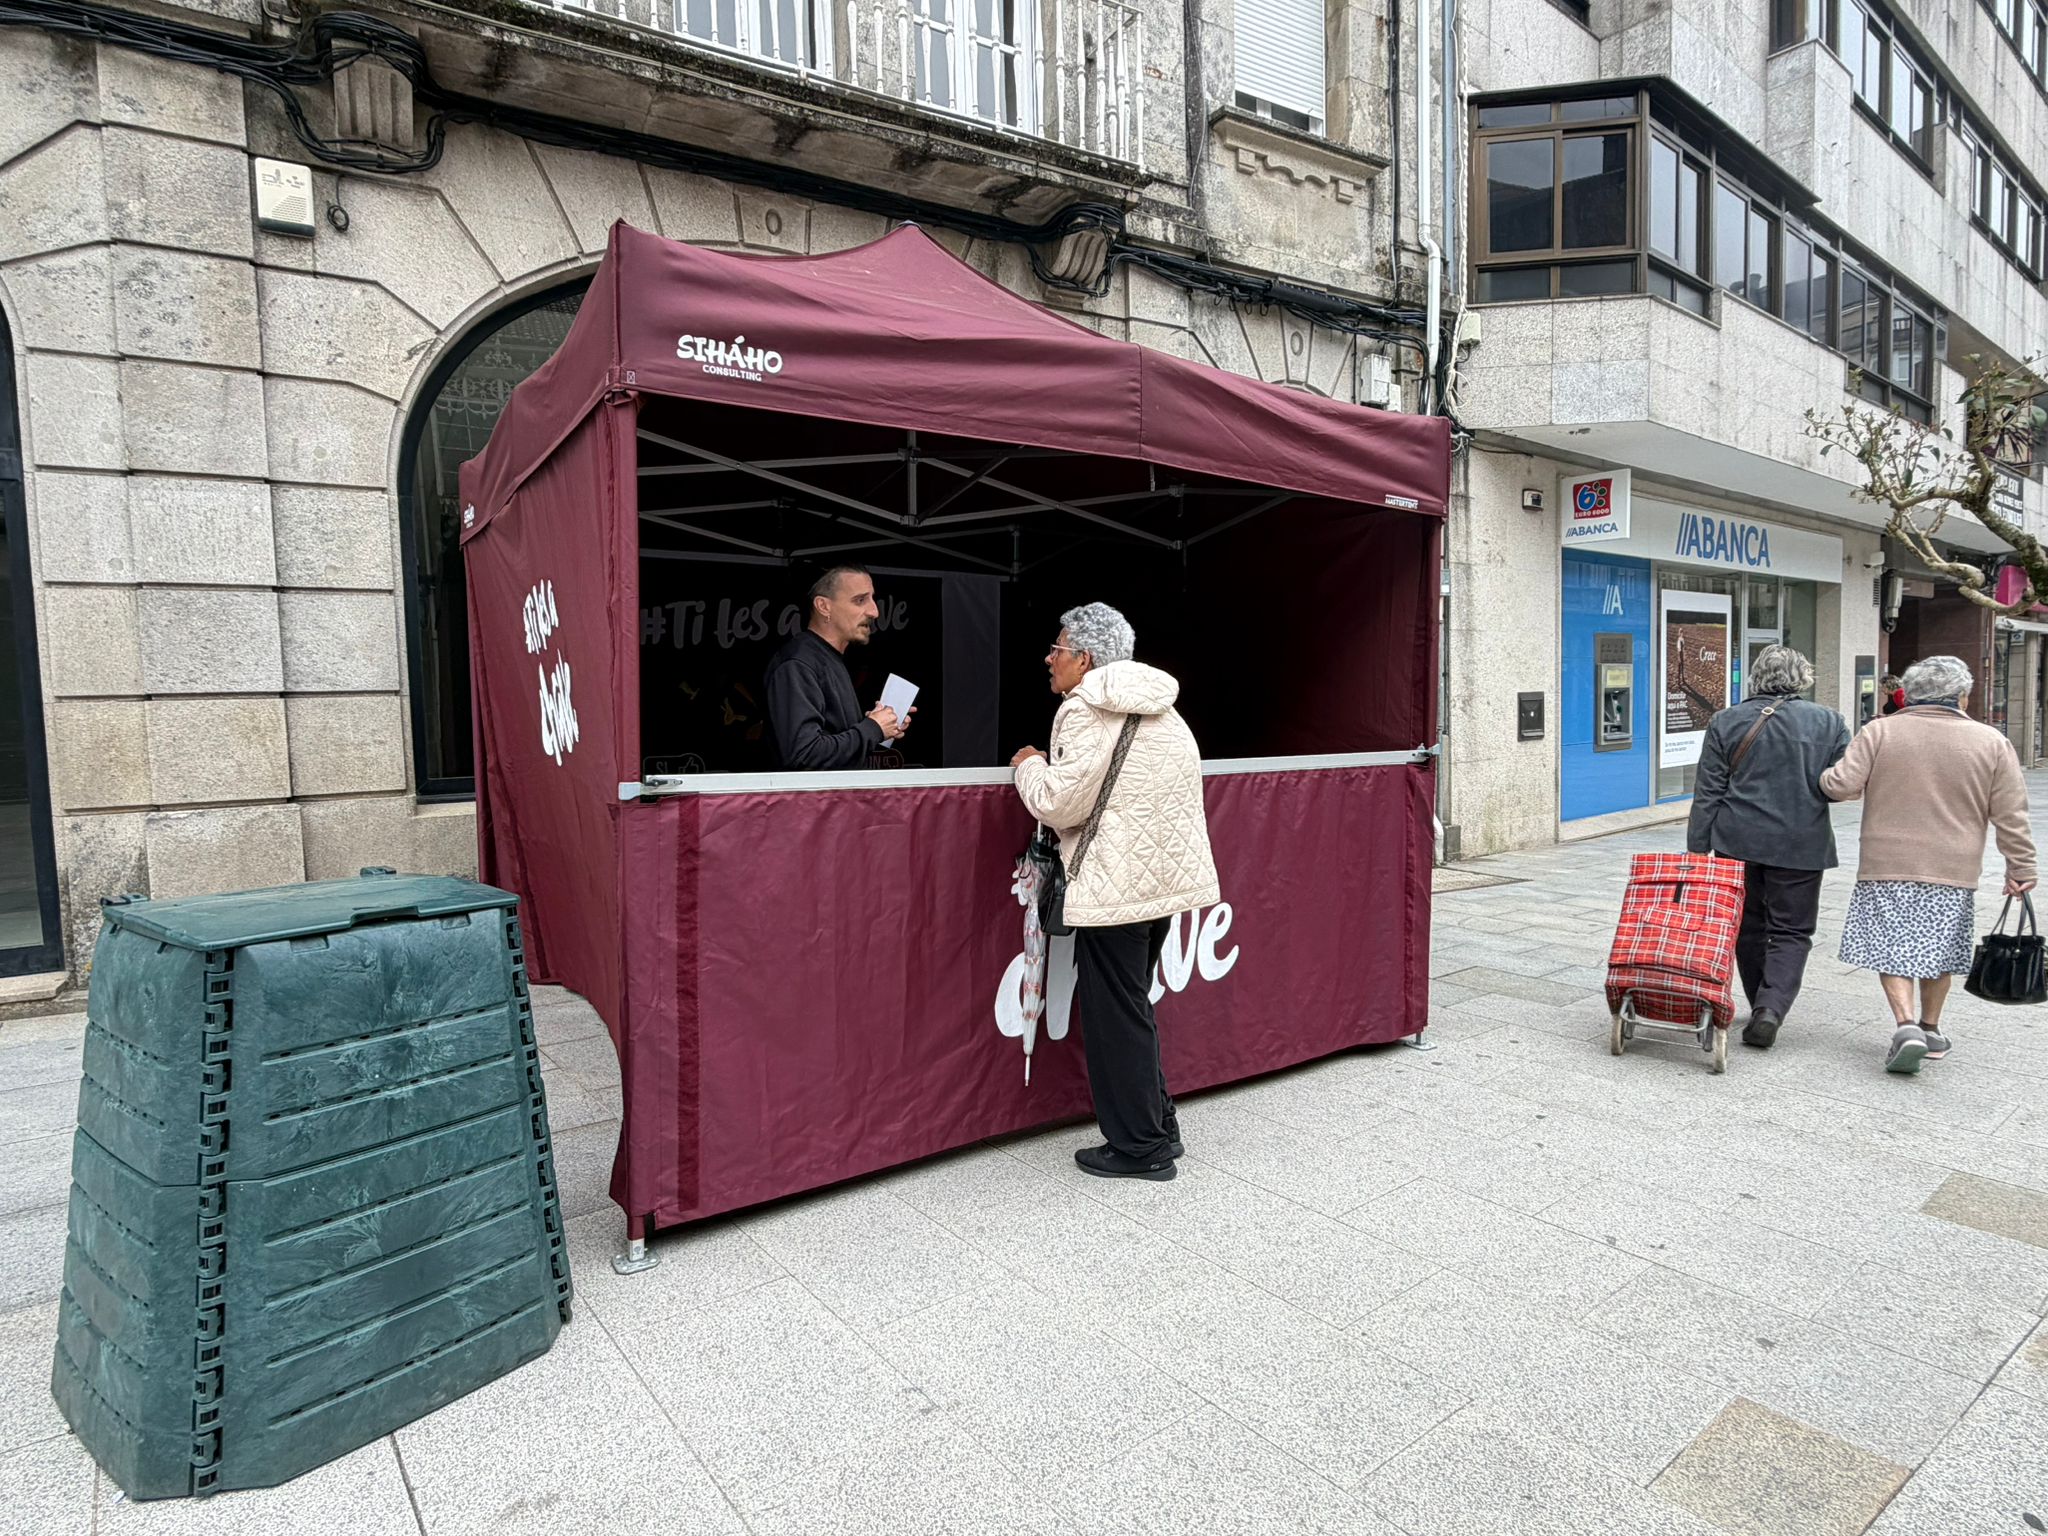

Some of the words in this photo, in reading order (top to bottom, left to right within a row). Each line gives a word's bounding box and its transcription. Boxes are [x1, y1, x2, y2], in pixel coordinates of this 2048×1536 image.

[676, 334, 783, 374] SIHÁHO
[702, 364, 763, 382] CONSULTING
[1592, 508, 1610, 516] 6000
